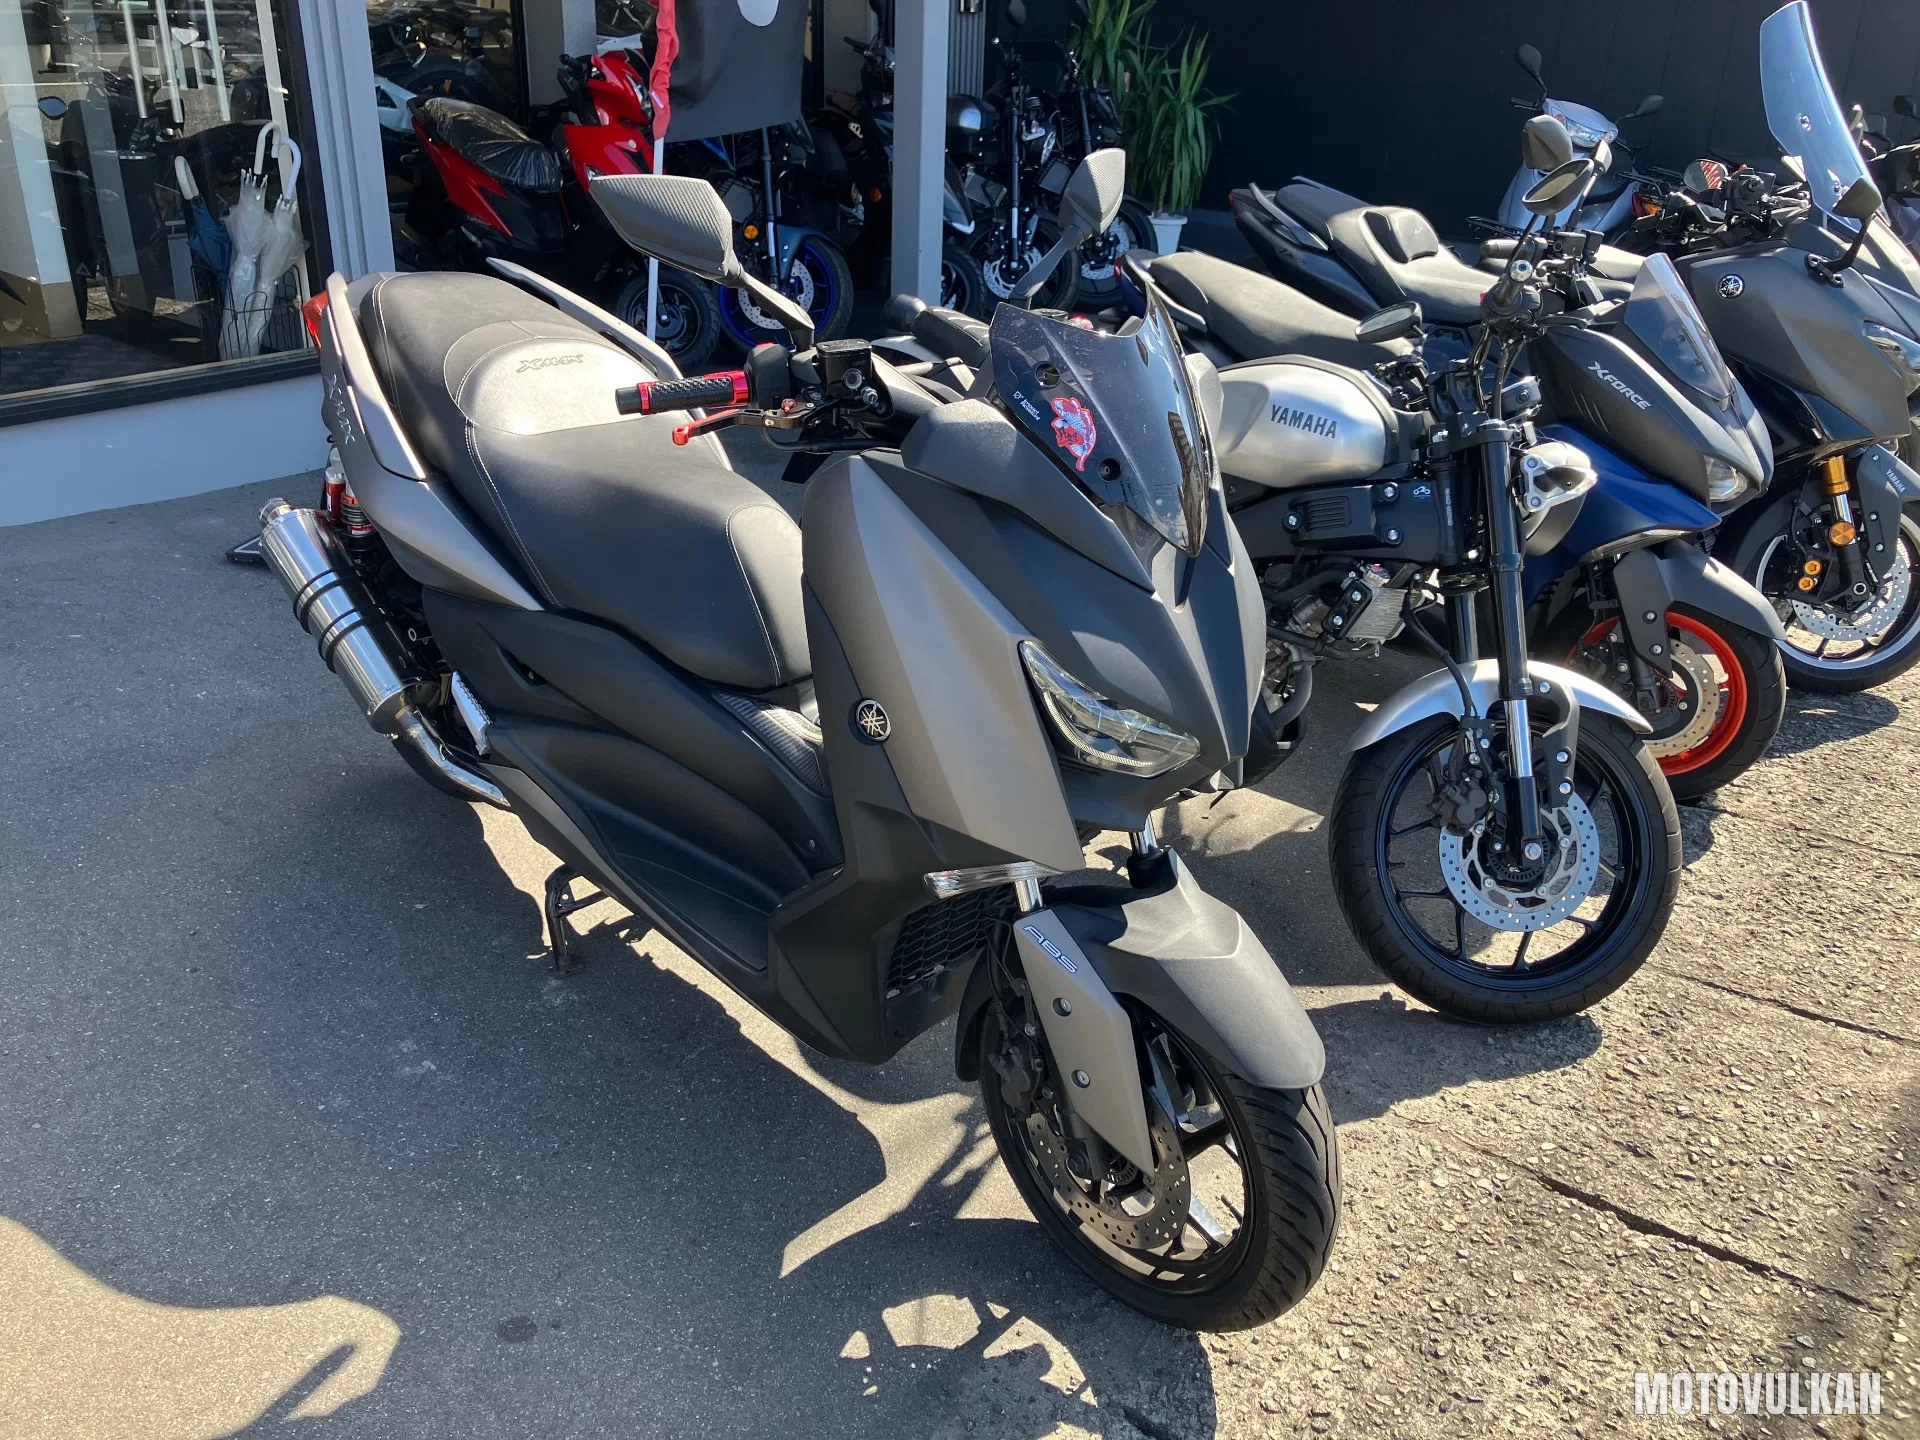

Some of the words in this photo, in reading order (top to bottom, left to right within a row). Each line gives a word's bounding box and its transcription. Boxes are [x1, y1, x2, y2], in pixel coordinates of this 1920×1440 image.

[1588, 361, 1652, 410] XFORCE
[1271, 404, 1337, 438] YAMAHA
[1886, 469, 1906, 493] YAMAHA
[1023, 925, 1078, 973] ABS
